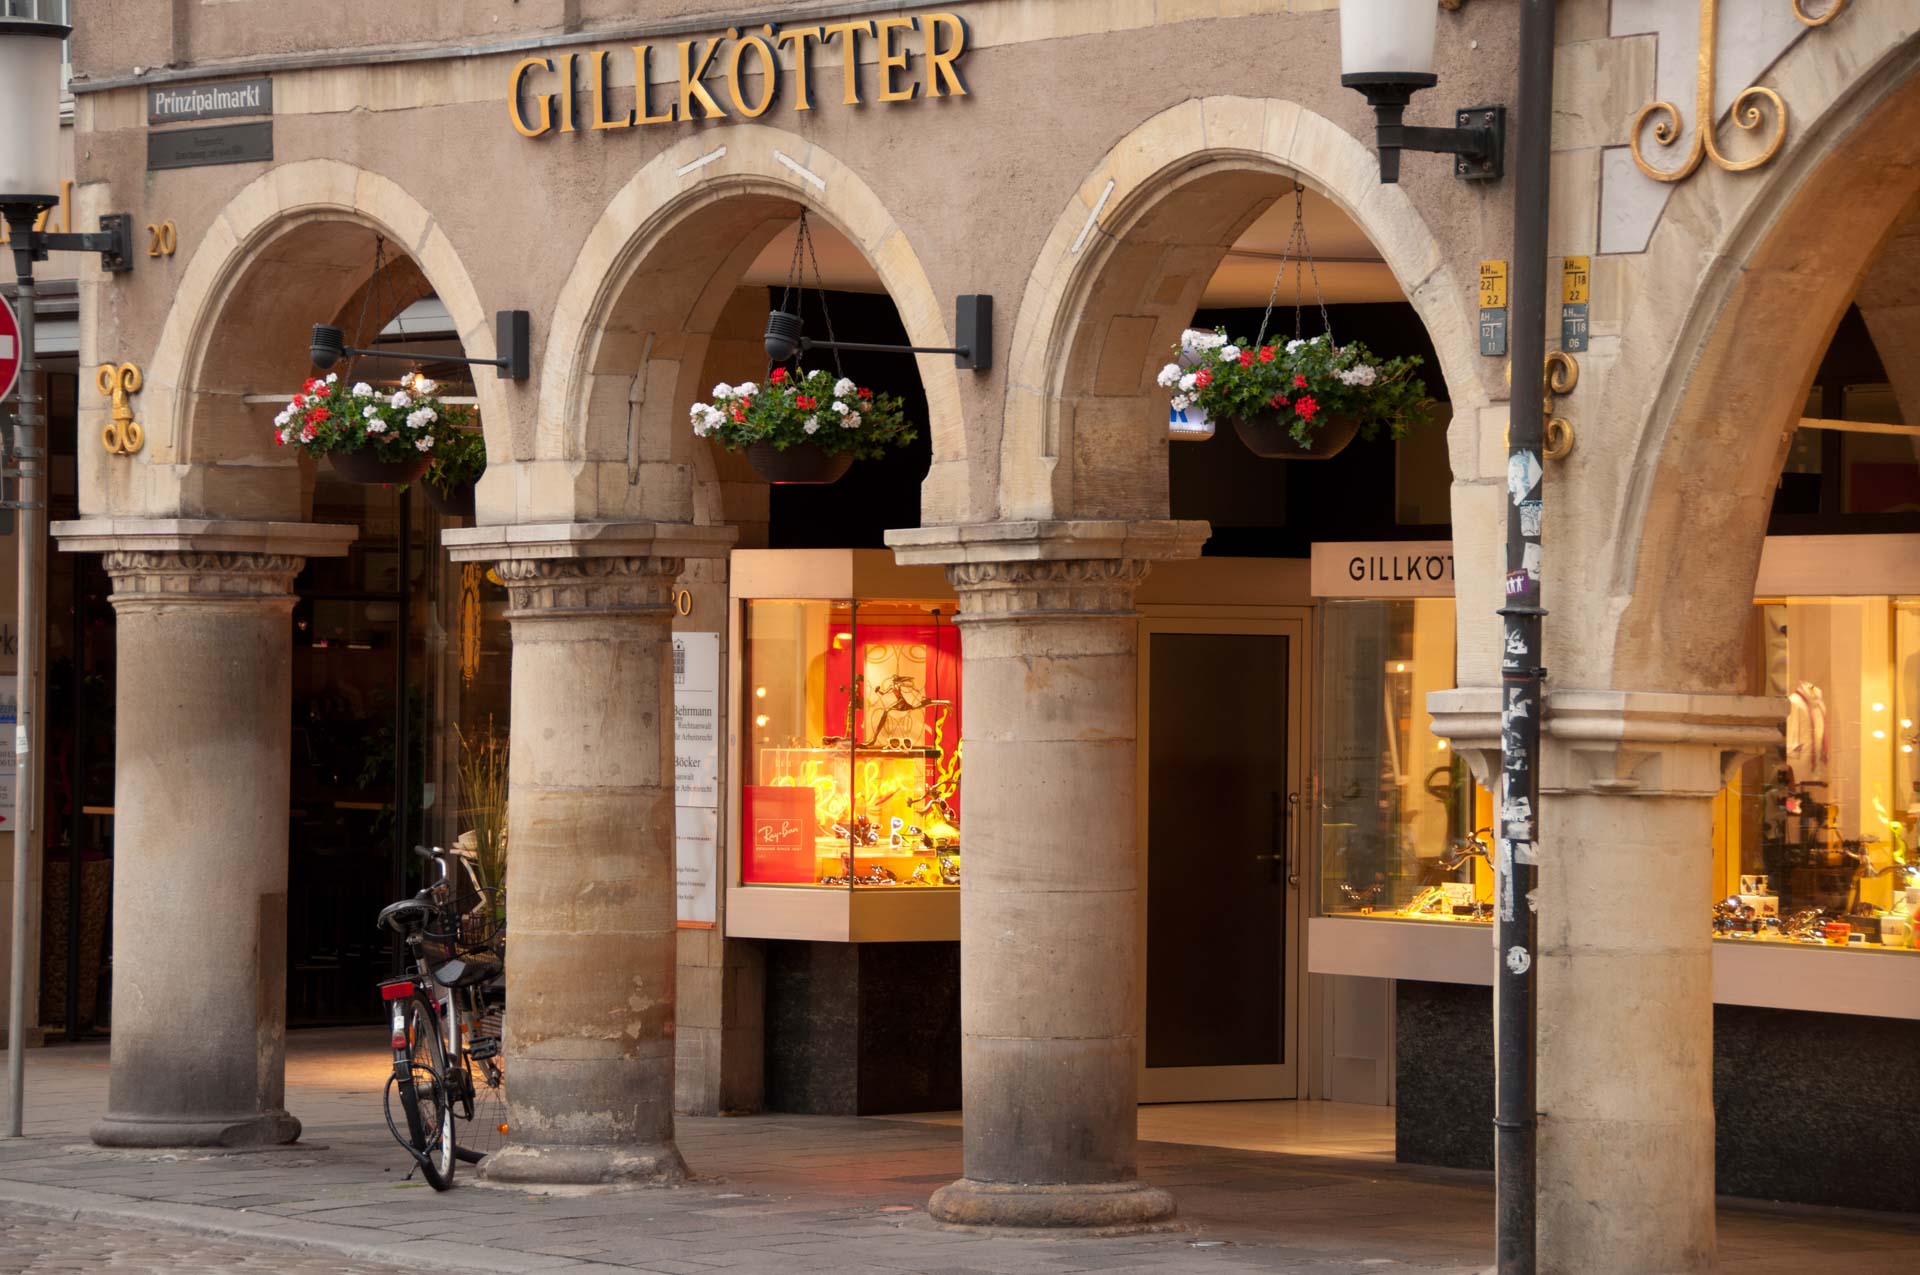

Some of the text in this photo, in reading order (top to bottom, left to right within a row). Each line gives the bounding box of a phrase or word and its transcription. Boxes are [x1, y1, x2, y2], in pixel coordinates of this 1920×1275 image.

[508, 13, 970, 137] GILLKÖTTER
[155, 85, 260, 115] Prinzipalmarkt
[146, 221, 177, 257] 20
[1480, 280, 1491, 290] 22
[1486, 295, 1499, 305] 22
[1569, 290, 1580, 301] 22
[1482, 327, 1490, 337] 12
[758, 820, 799, 843] Ray-Ban
